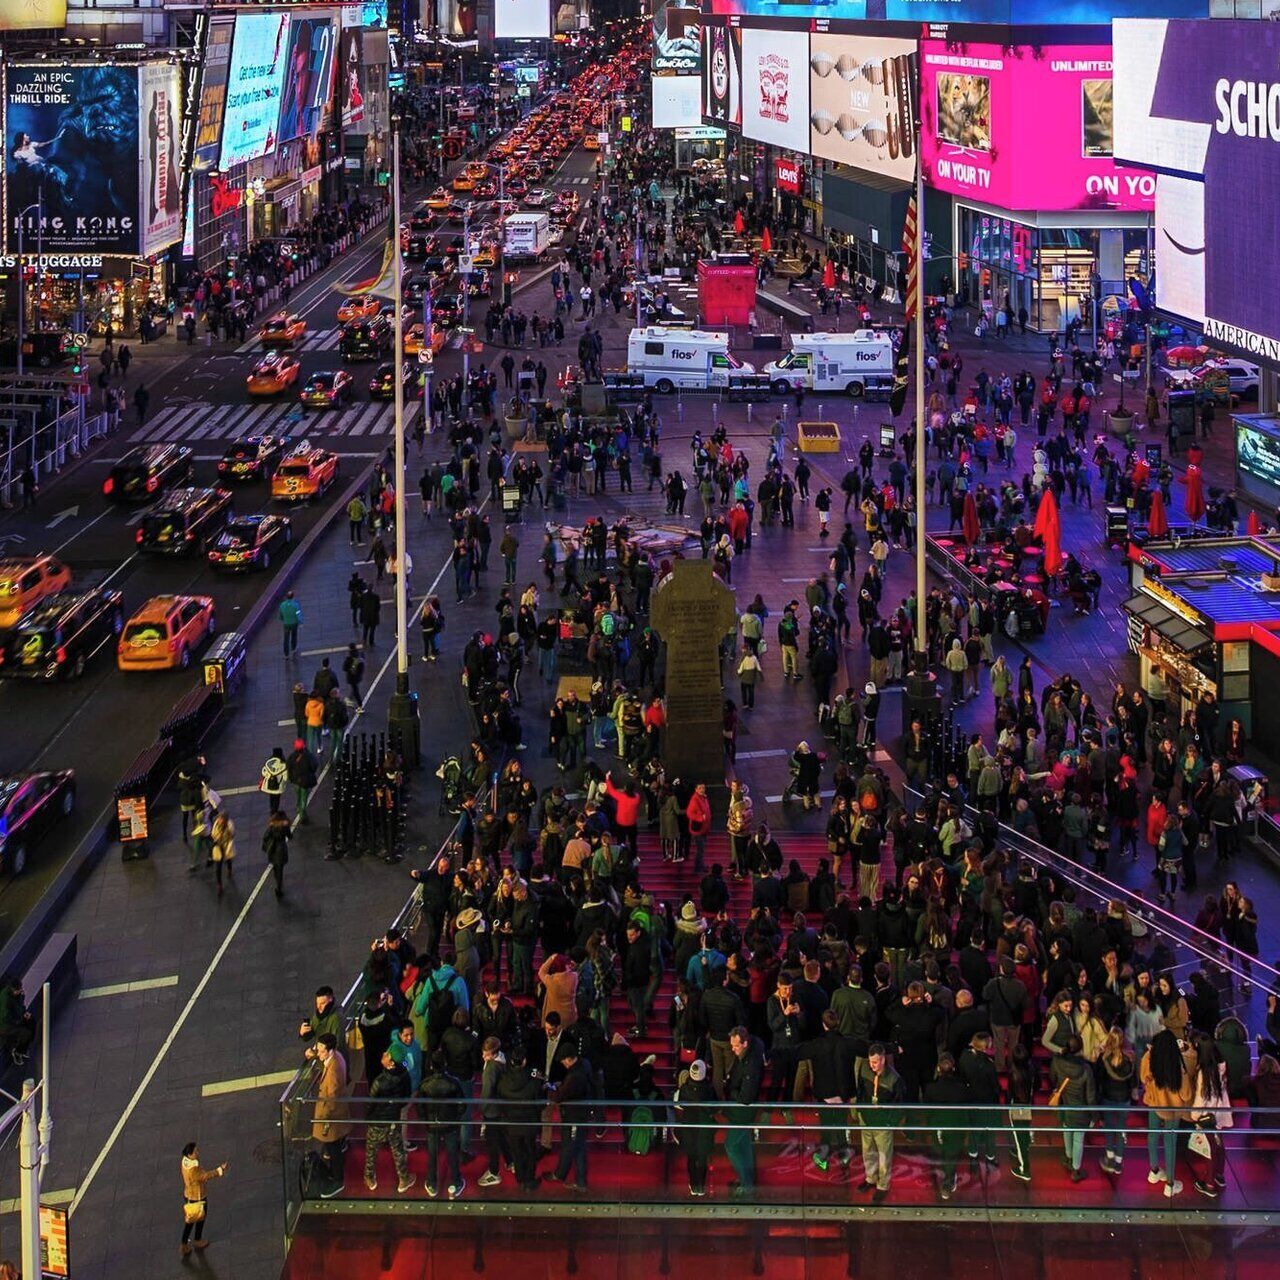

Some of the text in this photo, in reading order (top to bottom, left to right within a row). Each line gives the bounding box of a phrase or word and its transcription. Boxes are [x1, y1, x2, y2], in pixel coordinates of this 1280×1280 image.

[16, 83, 63, 94] DAZZLING
[10, 94, 42, 104] THRILL
[937, 159, 991, 189] ON YOUR TV
[13, 216, 64, 229] KING
[76, 216, 133, 229] KONG
[1204, 318, 1279, 364] AMERICAN
[671, 349, 693, 362] fios
[856, 350, 877, 363] fios
